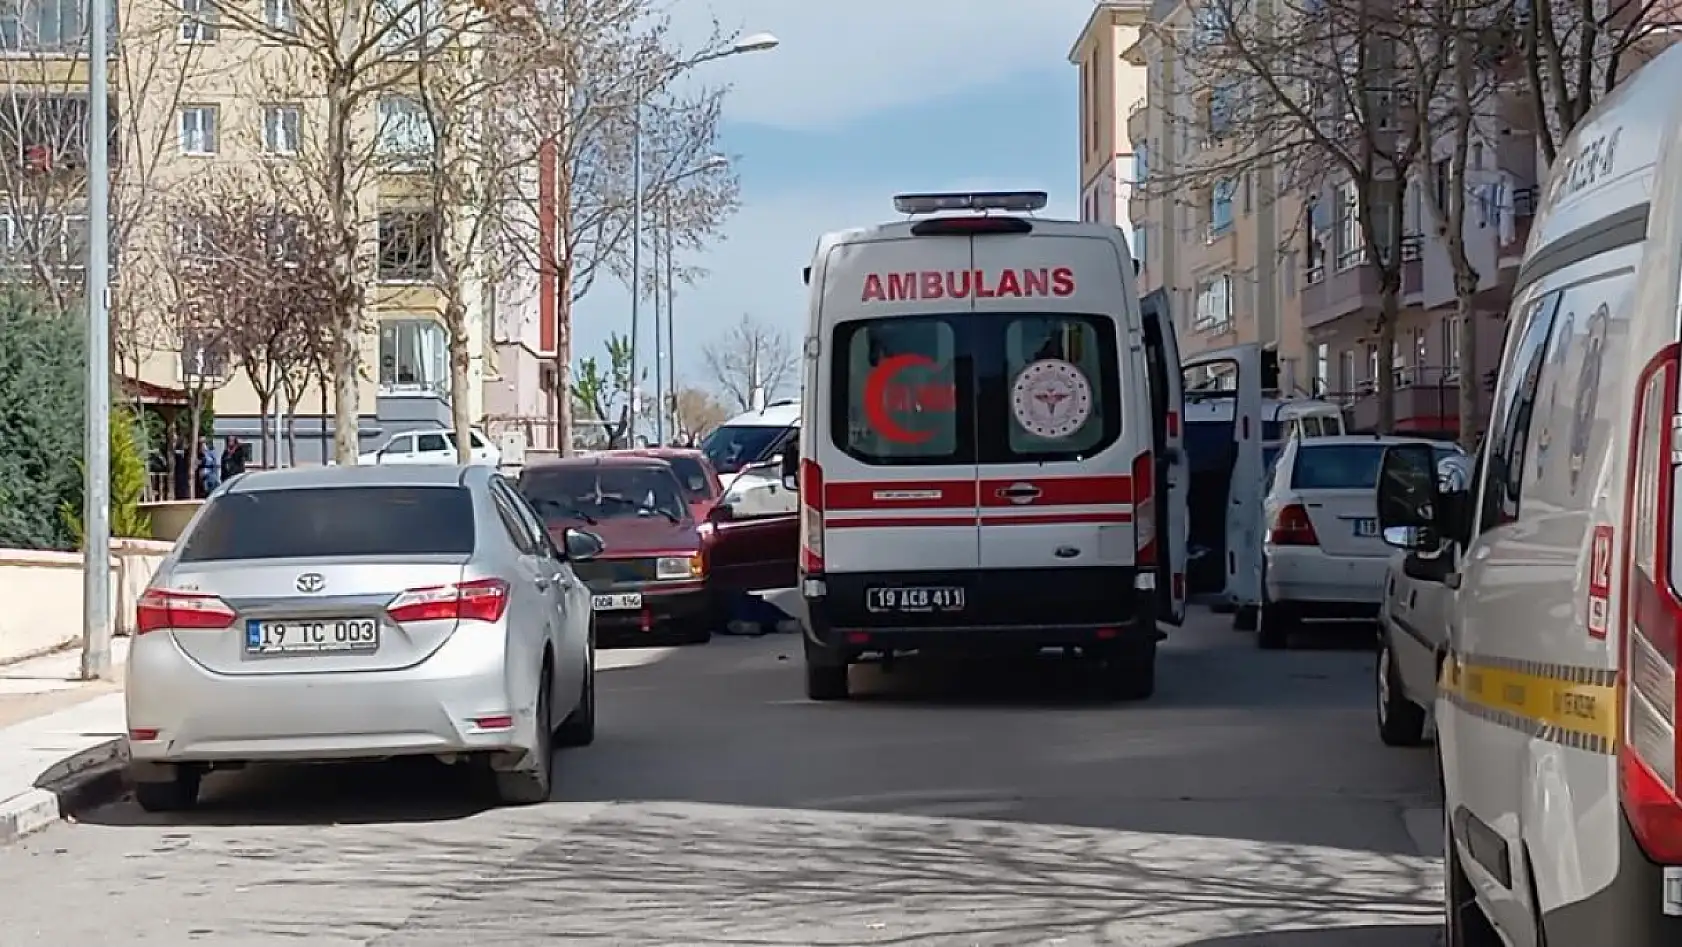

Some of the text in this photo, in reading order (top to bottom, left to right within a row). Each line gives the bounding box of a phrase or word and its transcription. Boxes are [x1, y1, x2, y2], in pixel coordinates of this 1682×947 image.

[861, 267, 1075, 302] AMBULANS
[878, 588, 961, 607] 19 ACB 411
[263, 624, 285, 643] 19
[300, 623, 325, 642] TC
[335, 621, 374, 642] 003
